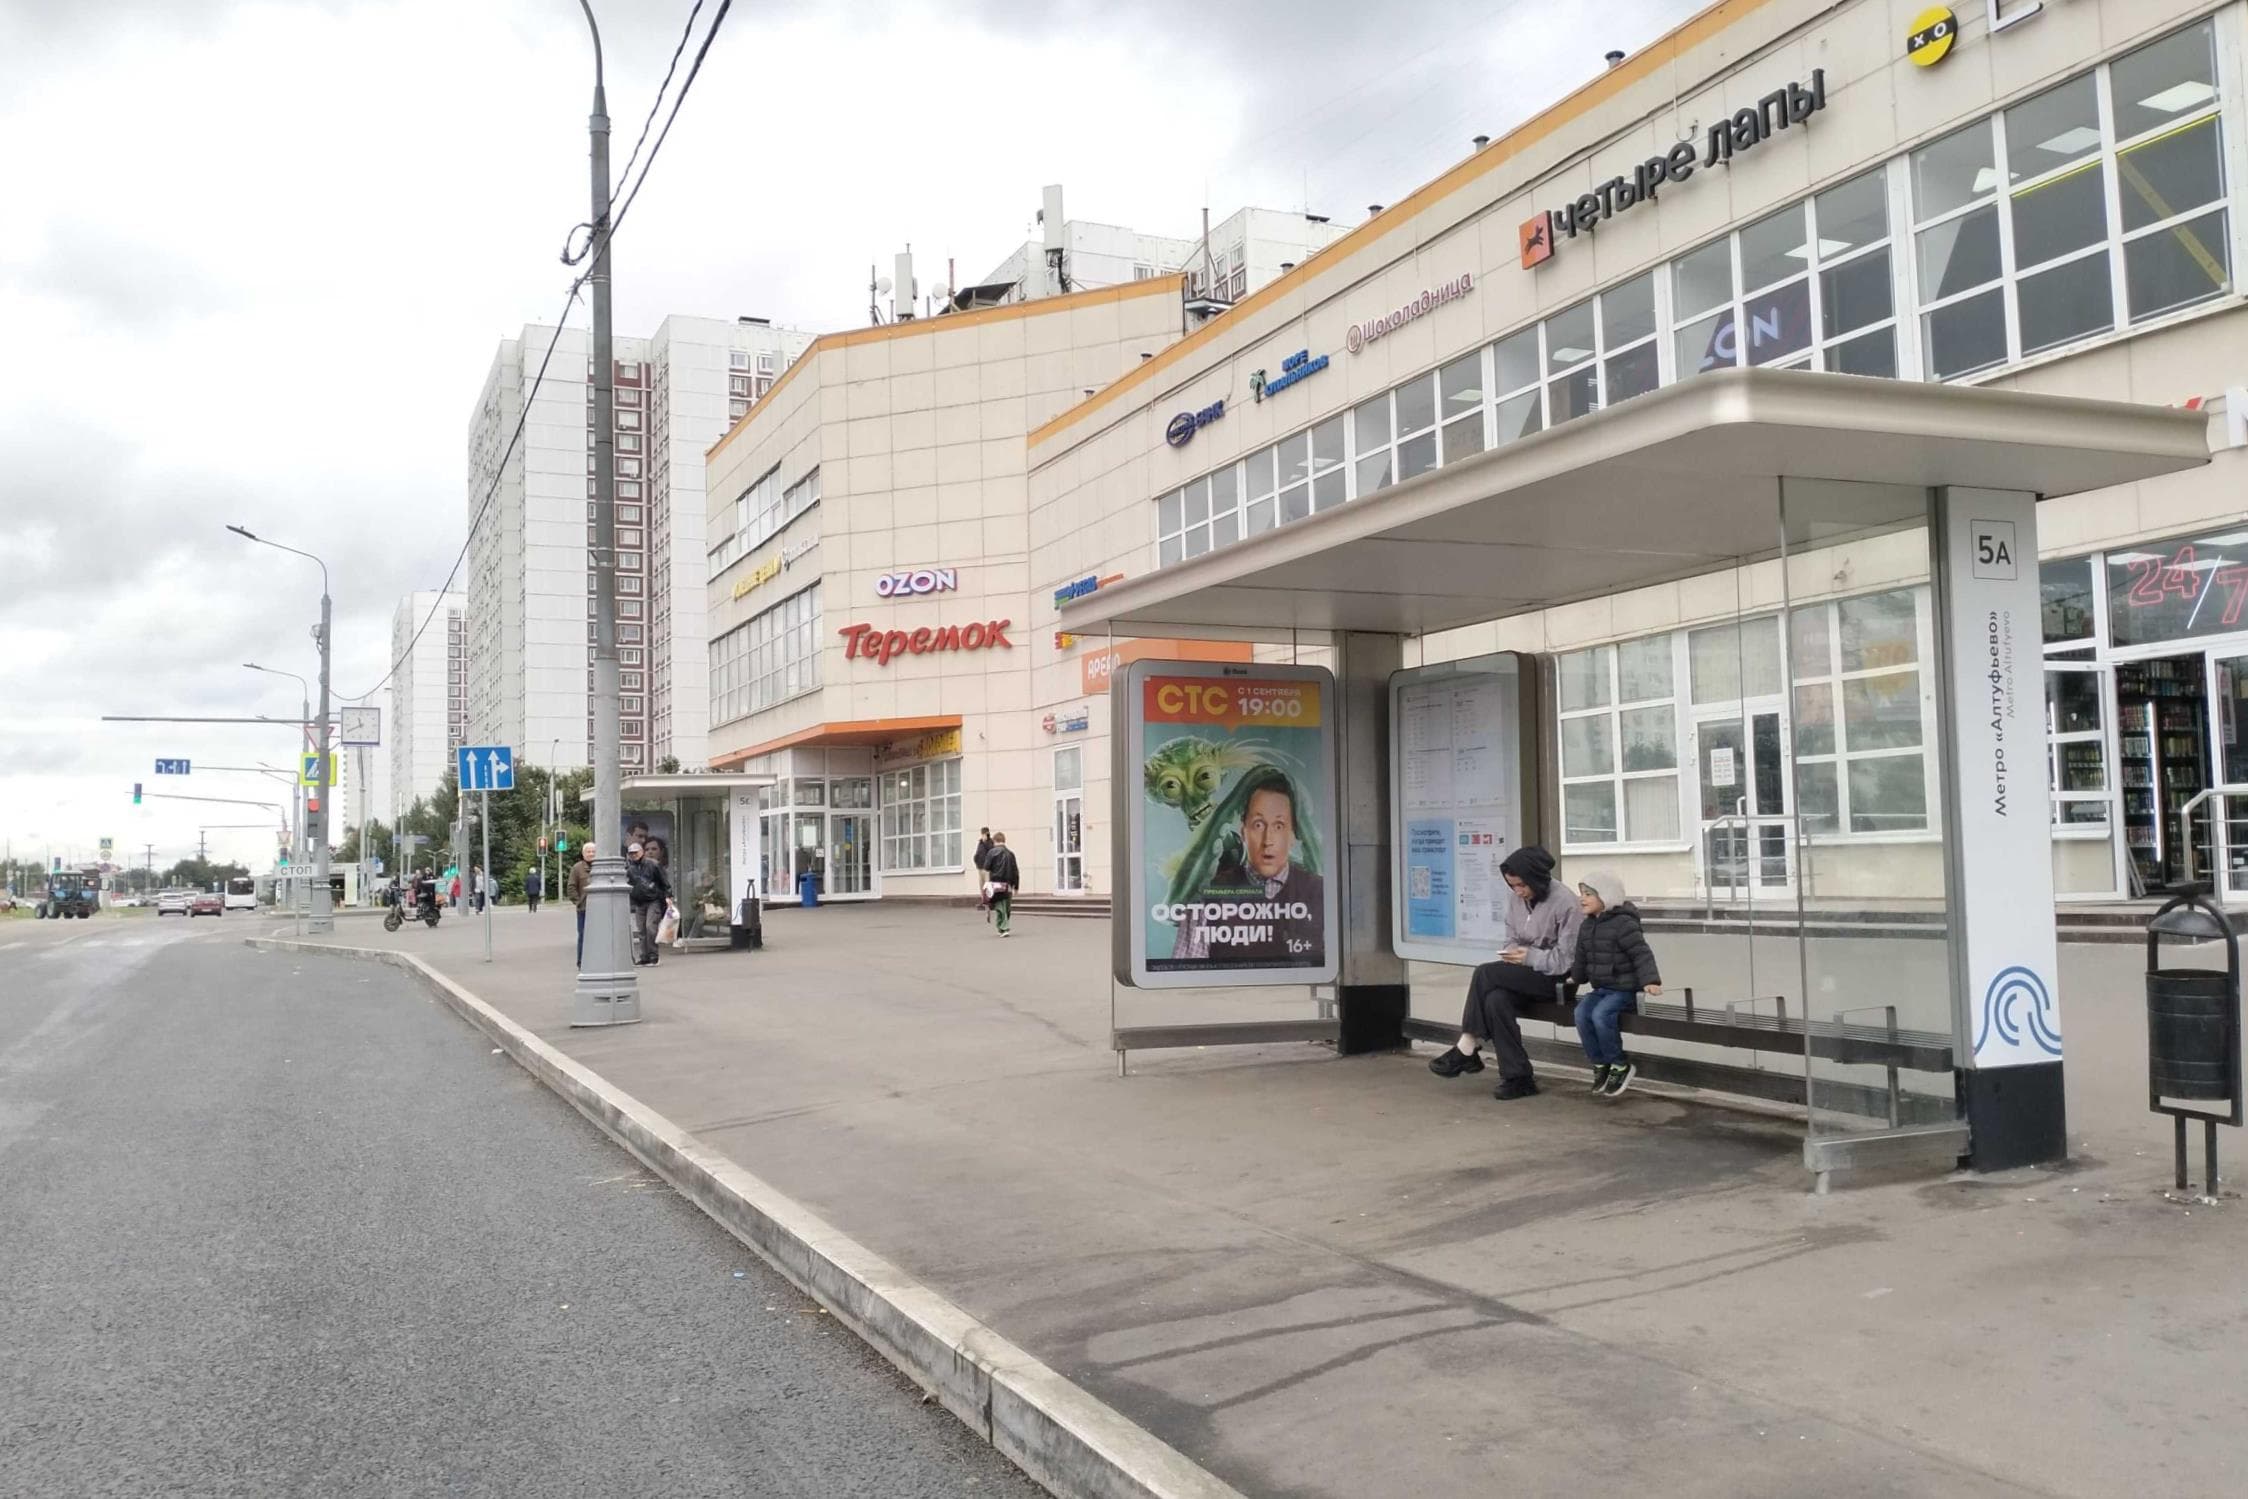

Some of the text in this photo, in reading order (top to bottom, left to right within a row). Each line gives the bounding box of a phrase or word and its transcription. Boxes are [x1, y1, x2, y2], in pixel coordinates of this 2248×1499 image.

[1553, 68, 1826, 238] четыре лапы
[1362, 272, 1472, 343] Шоколадница
[875, 568, 958, 598] OZON
[2127, 546, 2248, 629] 24/7
[838, 619, 1013, 667] Теремок
[1157, 684, 1229, 716] СТС
[1238, 698, 1302, 718] 19:00
[1987, 611, 2007, 816] Метро «Алтуфьево»
[2005, 677, 2015, 718] Metro
[281, 866, 313, 876] СТОП
[1151, 903, 1313, 921] ОСТОРОЖНО,
[1194, 925, 1273, 946] ЛЮДИ!
[1286, 938, 1312, 953] 16+
